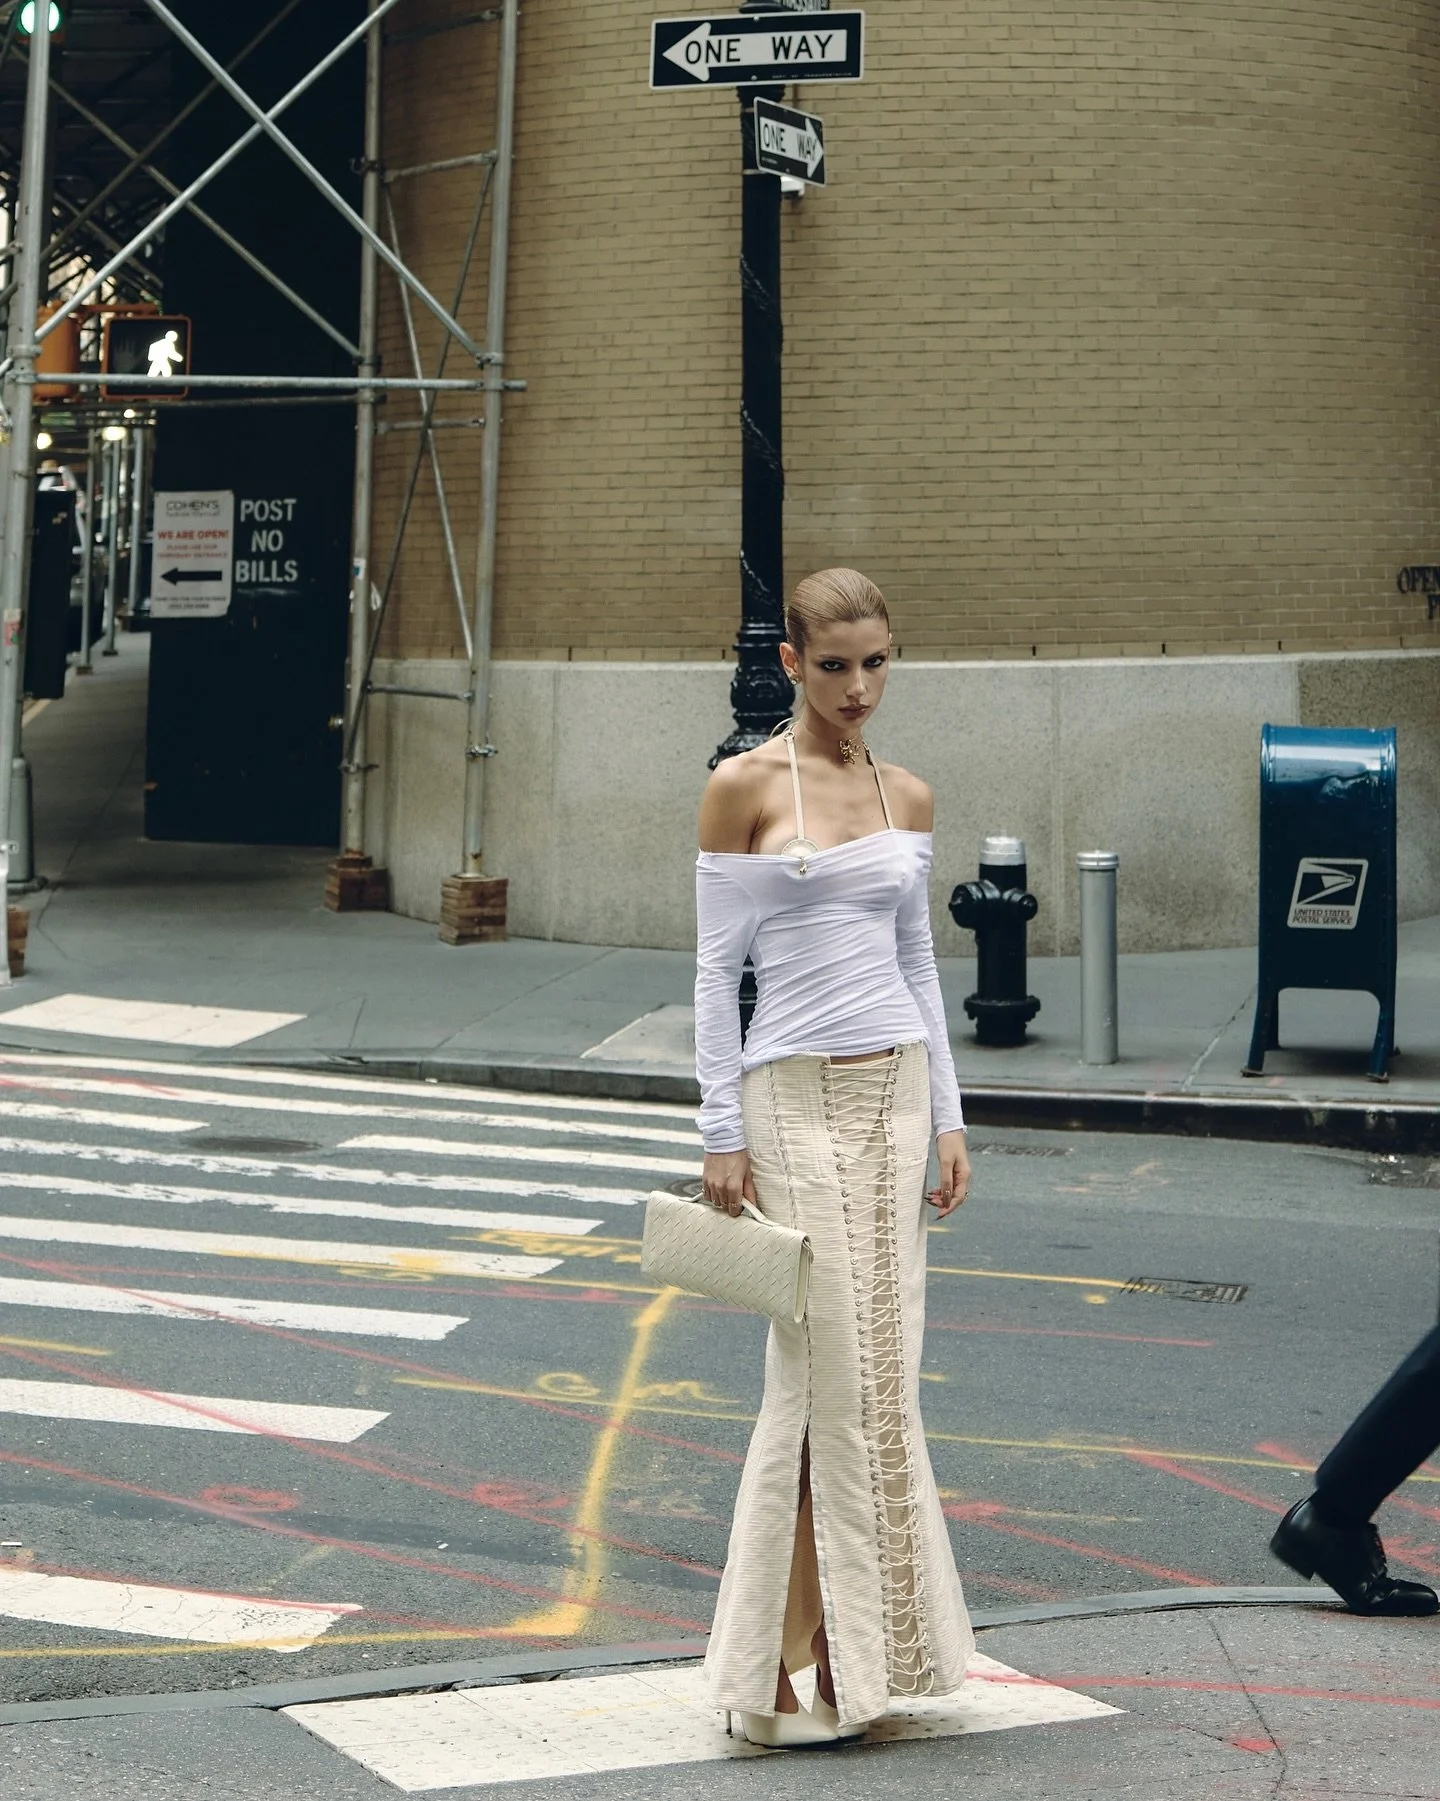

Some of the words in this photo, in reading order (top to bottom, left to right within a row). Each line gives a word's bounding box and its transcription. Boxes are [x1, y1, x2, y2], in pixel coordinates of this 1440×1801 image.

[685, 38, 741, 65] ONE
[771, 34, 833, 61] WAY
[762, 123, 786, 152] ONE
[796, 133, 817, 161] WAY
[240, 498, 297, 522] POST
[158, 530, 173, 540] WE
[176, 529, 194, 540] ARE
[197, 529, 229, 540] OPEN!
[251, 529, 284, 552] NO
[235, 560, 298, 583] BILLS
[1294, 908, 1323, 916] UNITED
[1324, 909, 1350, 917] STATES
[1322, 917, 1351, 925] SERVICE
